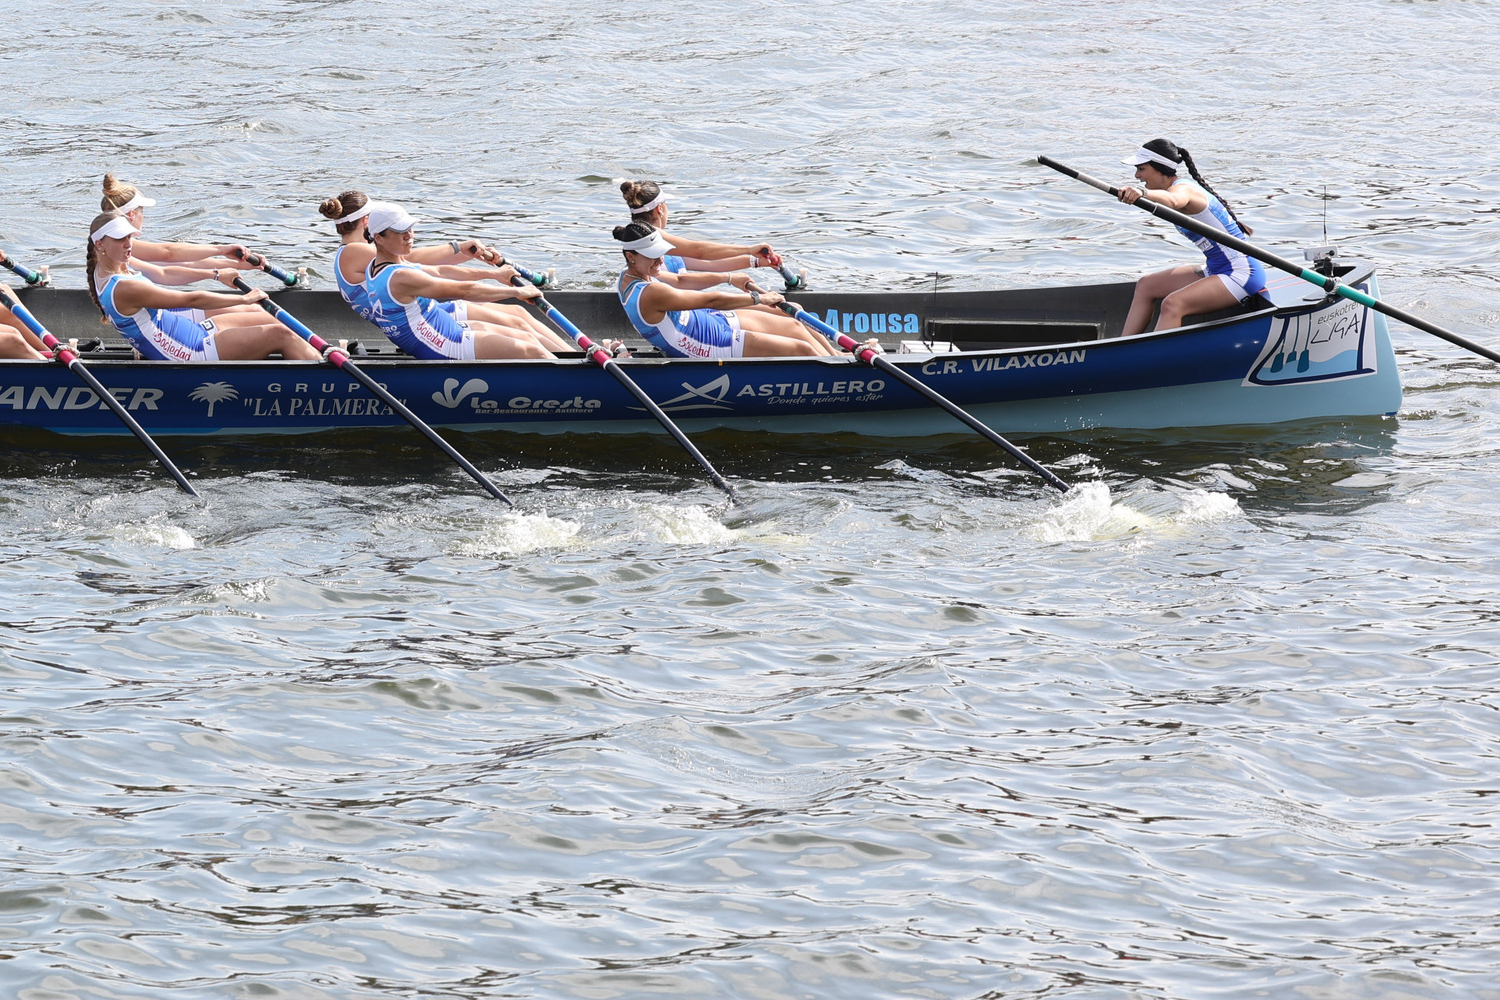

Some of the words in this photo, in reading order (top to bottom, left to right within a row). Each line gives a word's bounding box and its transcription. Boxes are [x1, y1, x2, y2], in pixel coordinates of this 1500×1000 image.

[823, 308, 919, 335] Arousa
[1310, 315, 1361, 345] LIGA
[921, 357, 963, 377] C.R.
[268, 383, 388, 394] GRUPO
[736, 379, 885, 397] ASTILLERO
[508, 396, 601, 409] Cresta
[767, 395, 806, 405] Donde
[811, 394, 850, 405] quieres
